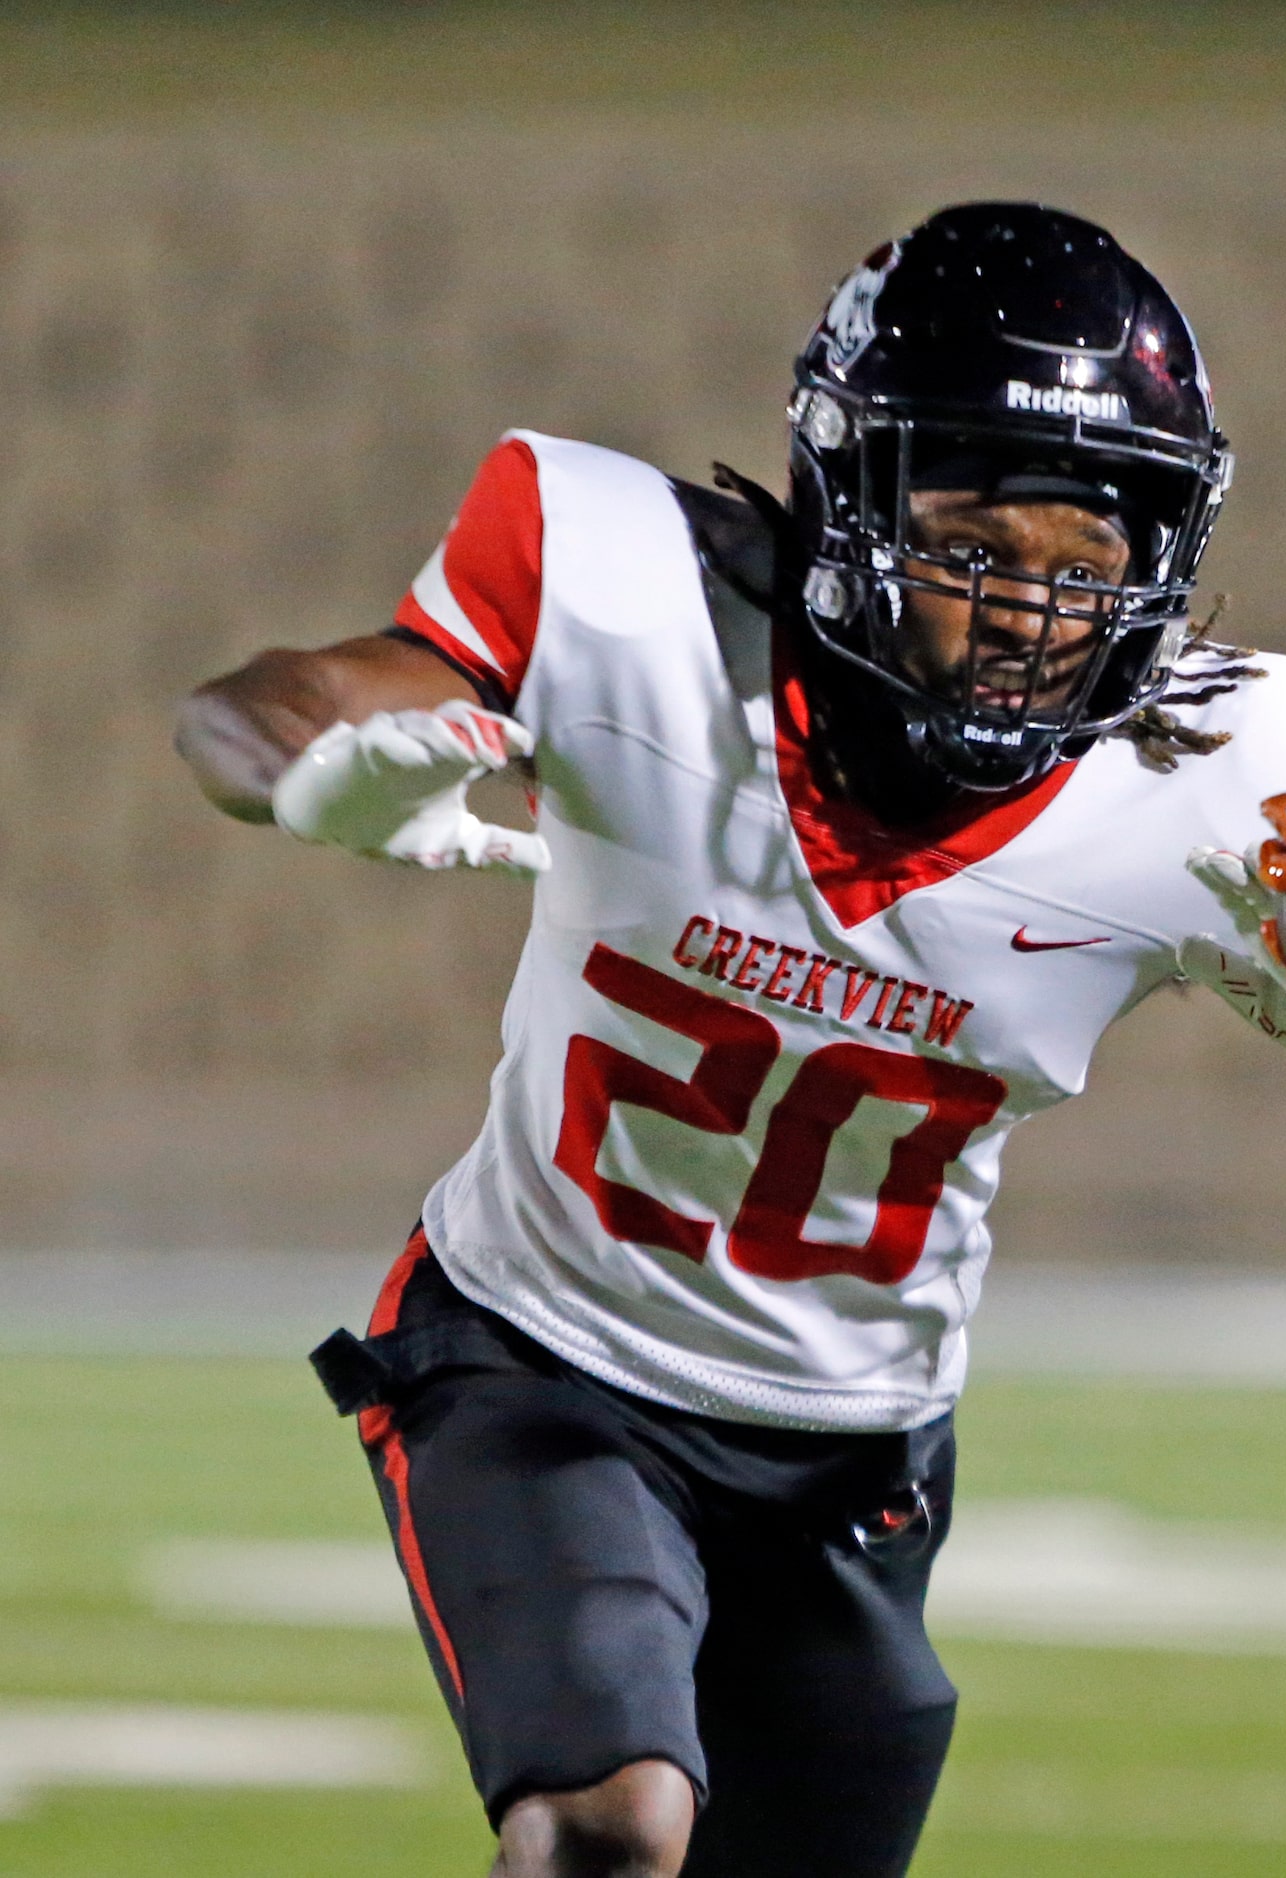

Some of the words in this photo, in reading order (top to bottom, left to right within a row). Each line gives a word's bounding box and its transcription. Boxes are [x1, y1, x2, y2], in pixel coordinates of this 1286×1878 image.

[1006, 379, 1120, 420] Riddell
[963, 723, 1023, 746] Ridell
[672, 914, 975, 1047] CREEKVIEW
[552, 940, 1009, 1286] 20
